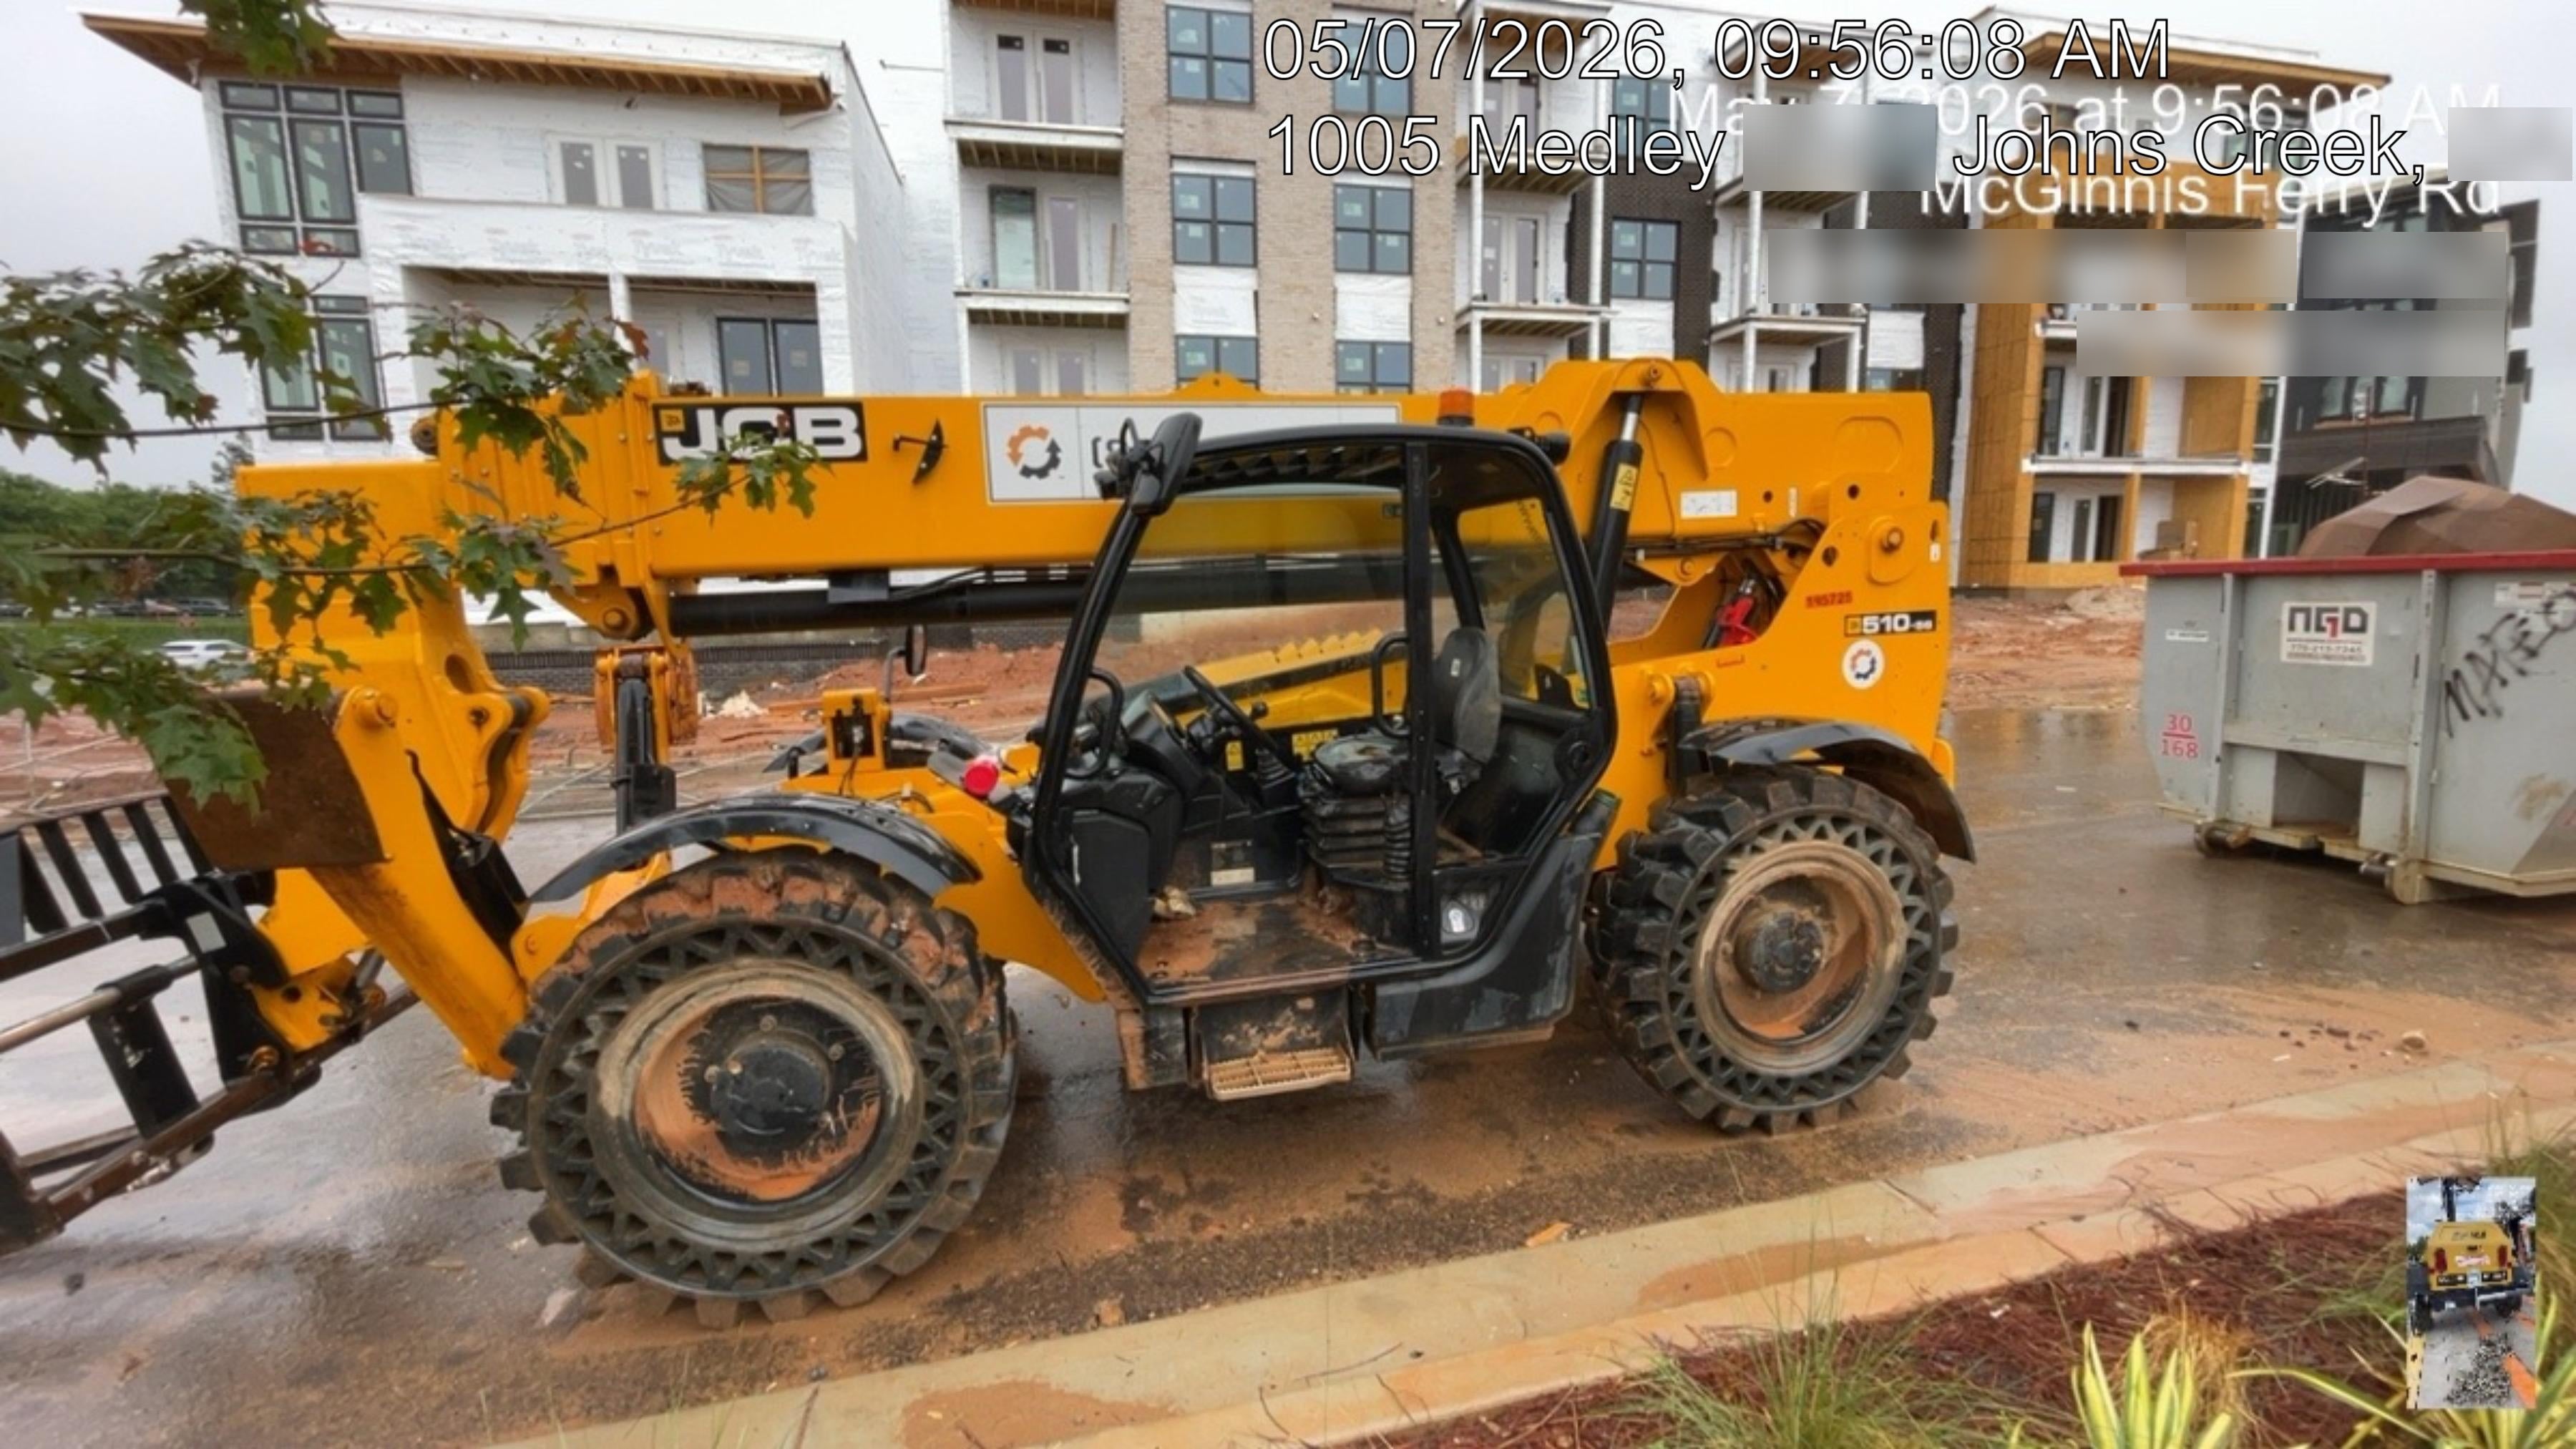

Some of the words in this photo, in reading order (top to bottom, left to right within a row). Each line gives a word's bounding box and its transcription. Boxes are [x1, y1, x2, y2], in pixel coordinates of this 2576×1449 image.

[662, 406, 862, 462] JCB
[2168, 715, 2192, 733] 30
[2162, 738, 2197, 759] 168
